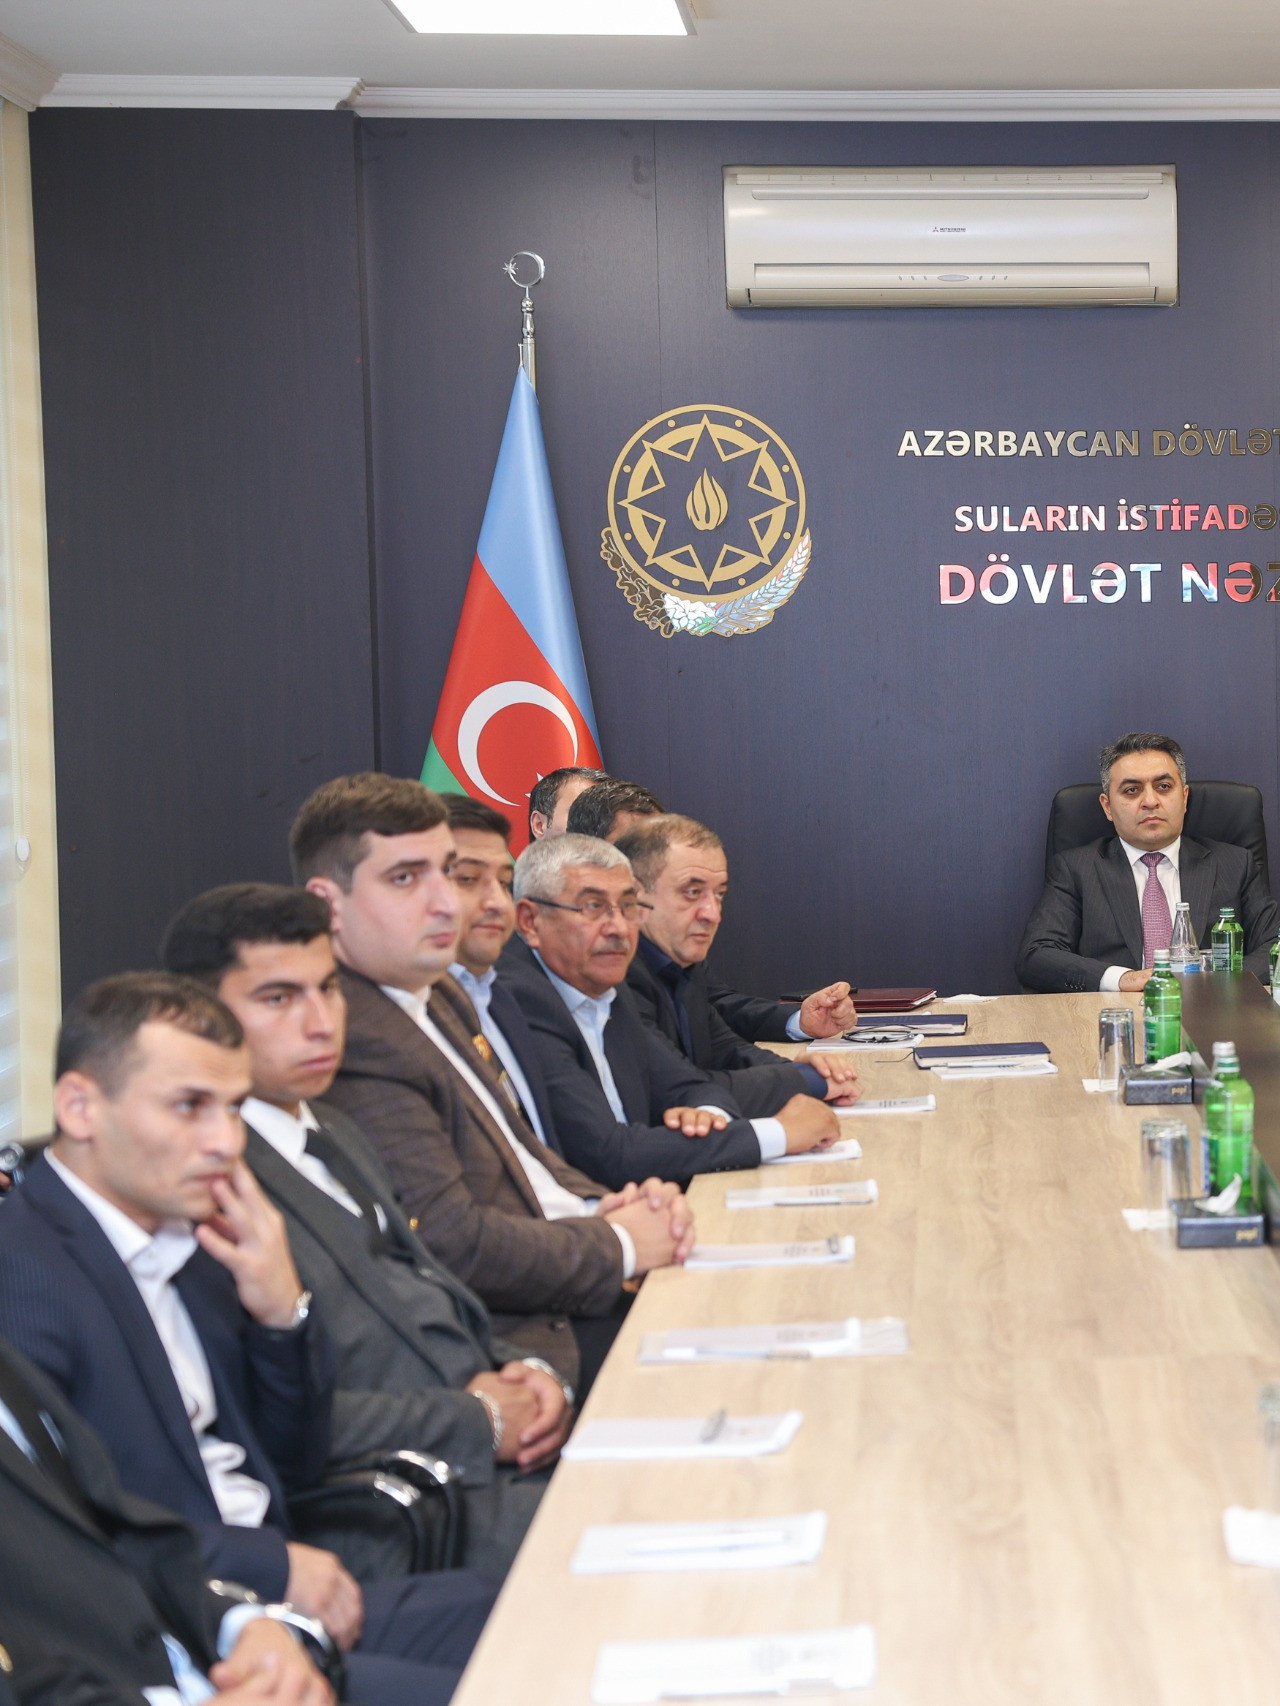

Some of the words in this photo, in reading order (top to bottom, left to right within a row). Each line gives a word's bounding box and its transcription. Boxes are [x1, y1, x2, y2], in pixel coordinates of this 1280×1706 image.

[897, 430, 1140, 457] AZƏRBAYCAN
[954, 505, 1106, 532] SULARIN
[938, 553, 1162, 605] DÖVLƏT
